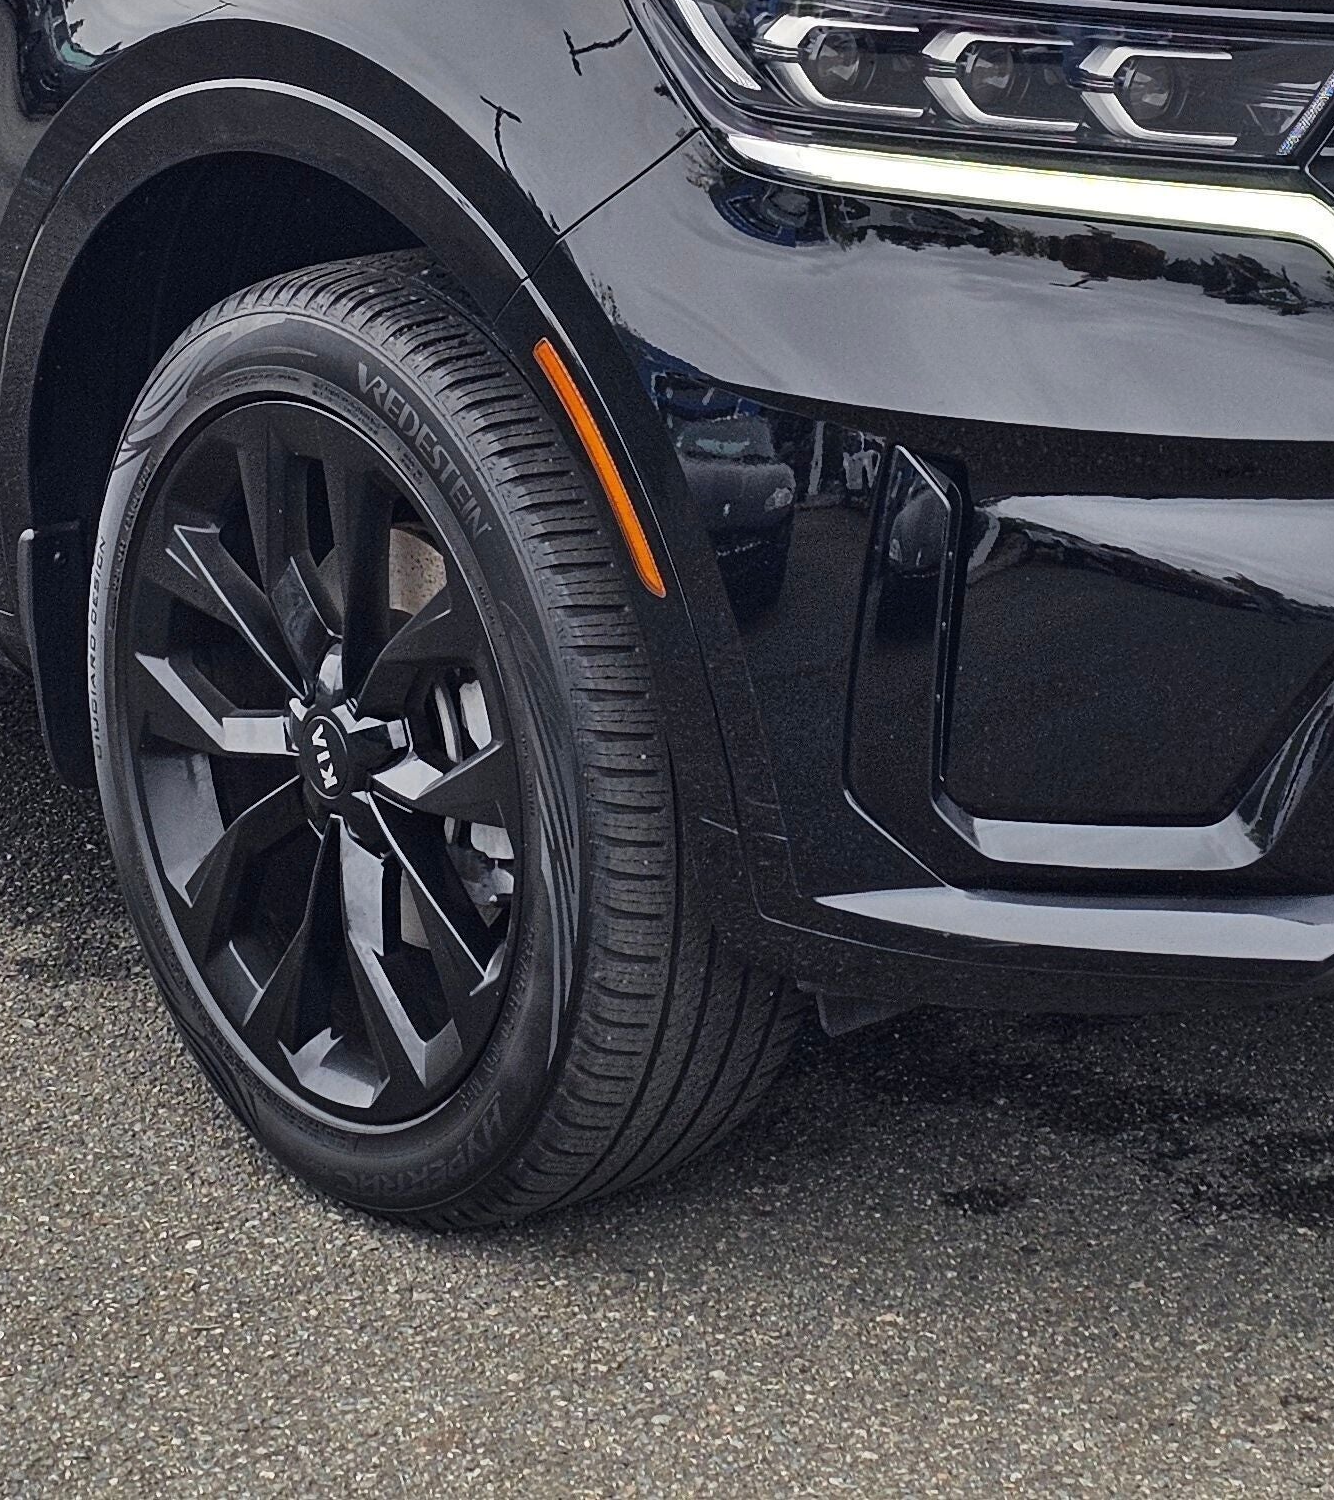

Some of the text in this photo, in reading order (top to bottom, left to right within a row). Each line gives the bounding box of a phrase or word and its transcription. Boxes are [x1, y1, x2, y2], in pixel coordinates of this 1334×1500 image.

[358, 362, 491, 540] VREDESTEIN
[90, 536, 106, 626] DESIGN
[311, 723, 338, 789] KIA
